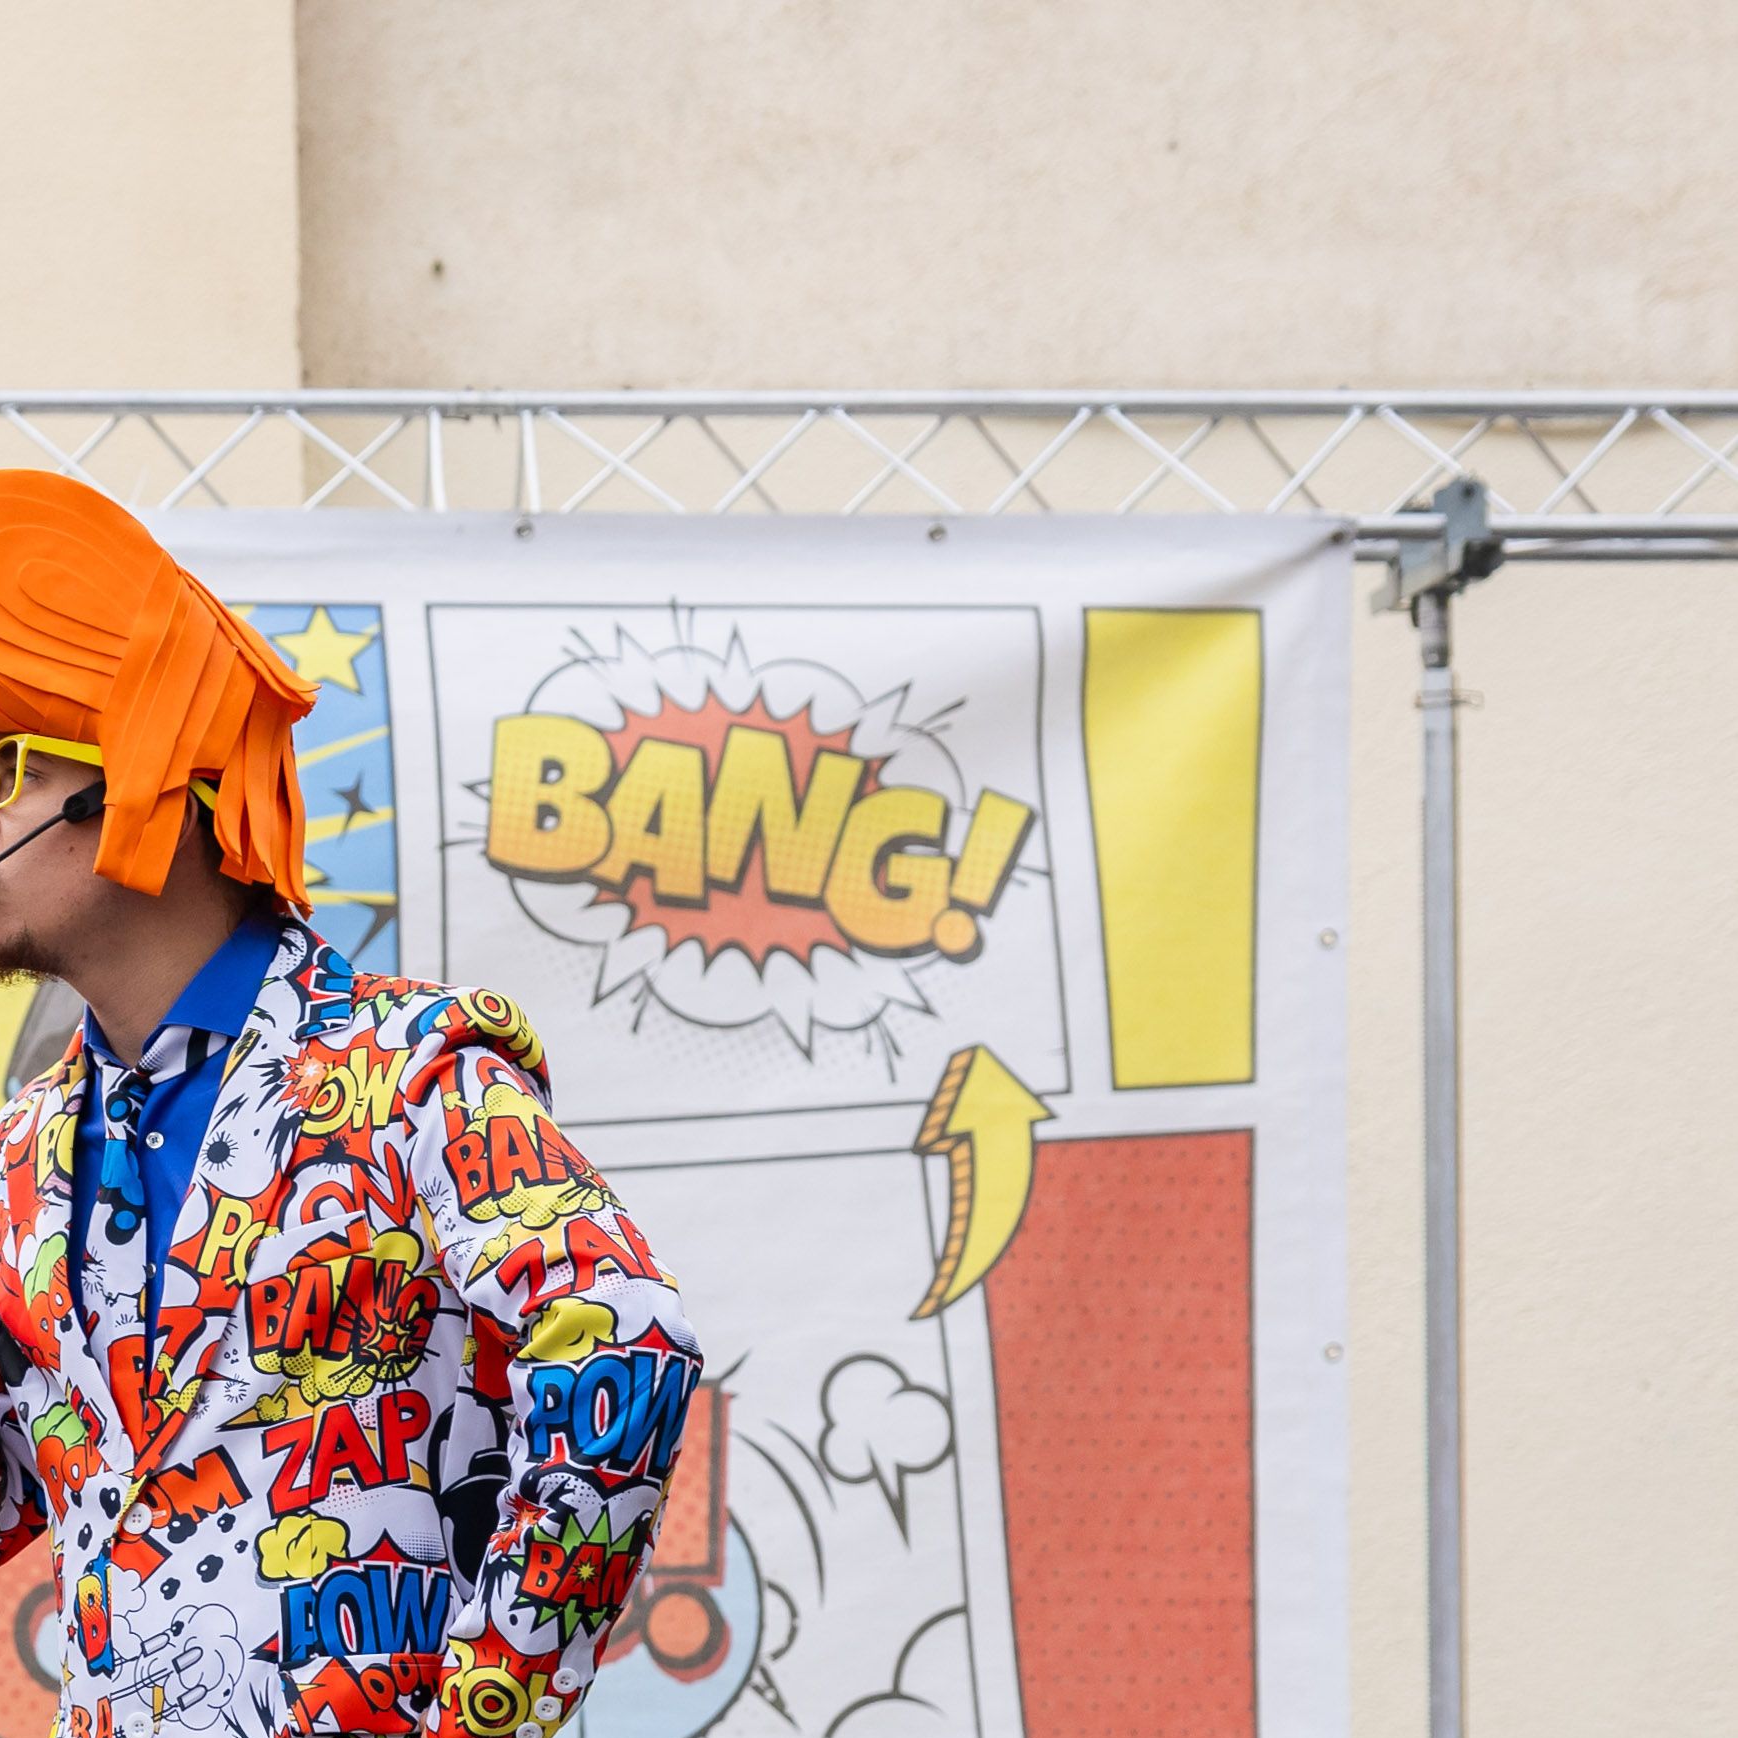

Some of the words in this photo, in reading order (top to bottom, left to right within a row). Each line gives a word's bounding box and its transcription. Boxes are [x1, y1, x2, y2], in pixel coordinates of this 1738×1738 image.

[485, 711, 1036, 965] BANG!
[247, 1256, 440, 1360] BANG
[262, 1389, 431, 1519] ZAP
